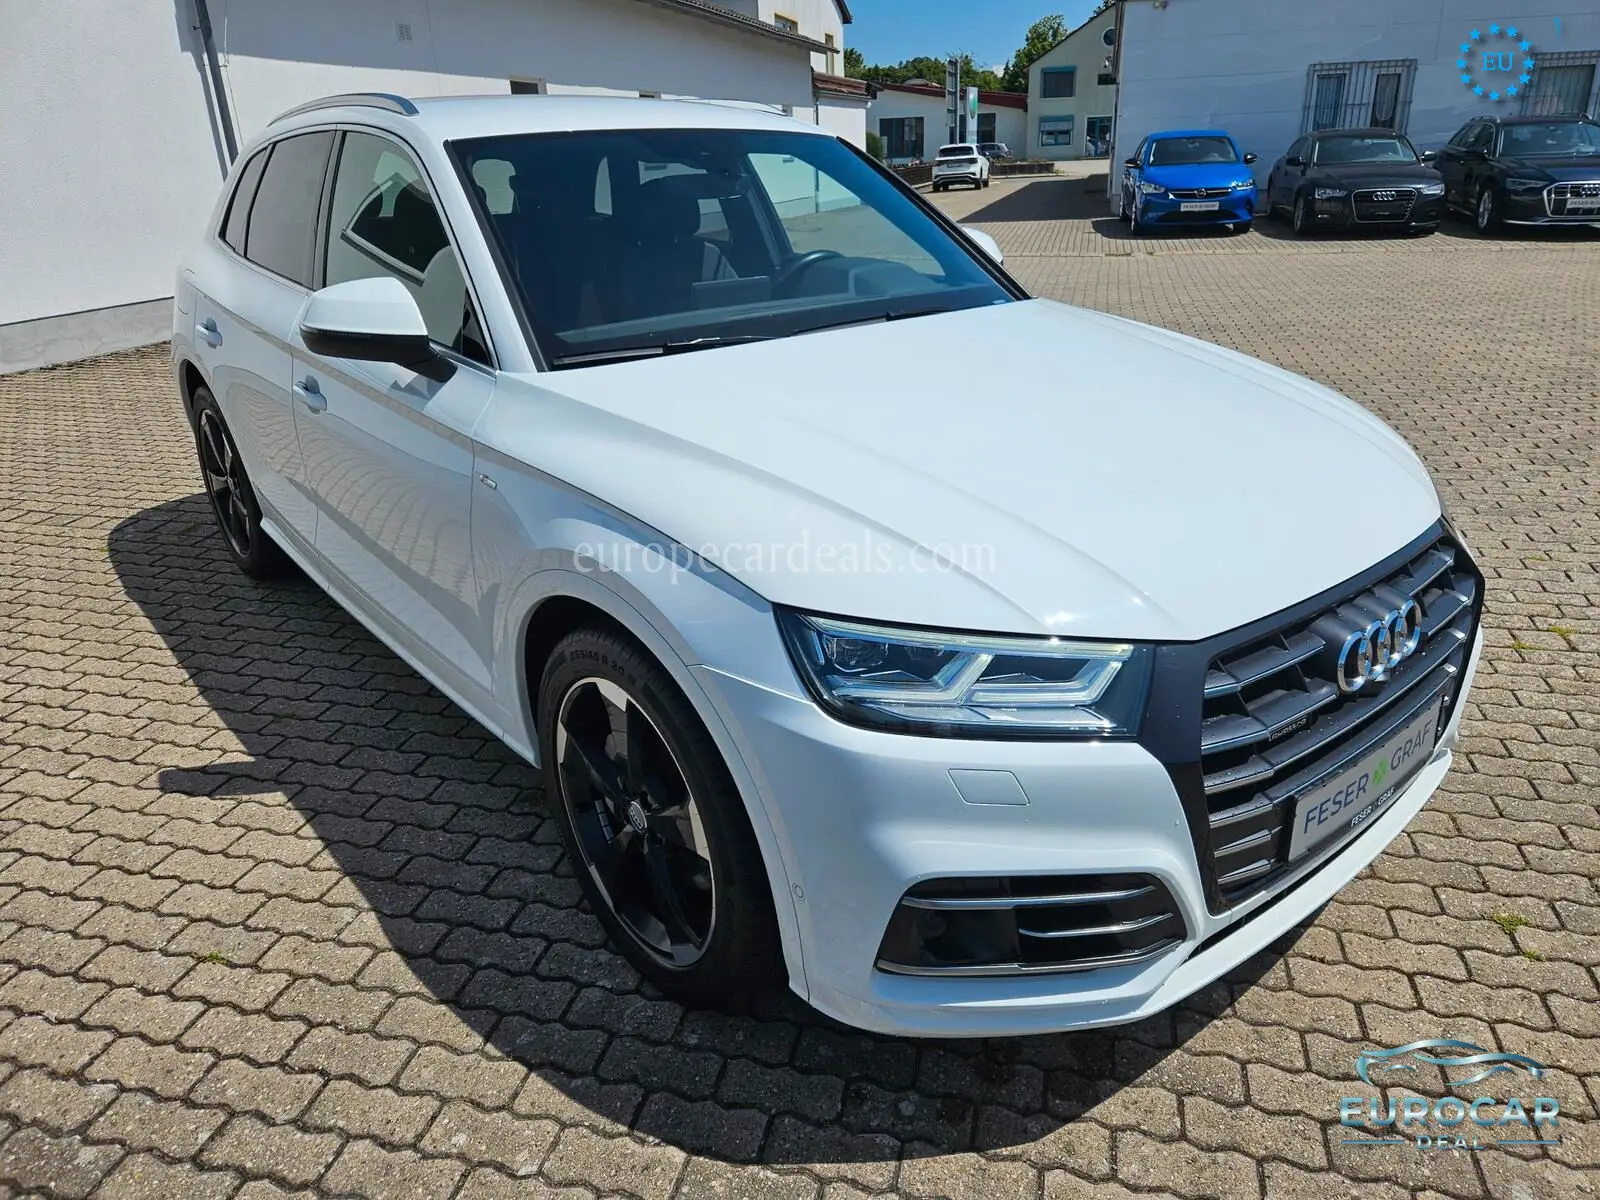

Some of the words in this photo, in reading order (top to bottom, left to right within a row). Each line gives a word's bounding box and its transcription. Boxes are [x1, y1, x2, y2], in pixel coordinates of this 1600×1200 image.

[611, 660, 625, 676] 20
[1304, 773, 1370, 834] FESER
[1390, 719, 1432, 771] GRAF
[1350, 805, 1373, 828] FESER
[1377, 785, 1396, 806] GRAF
